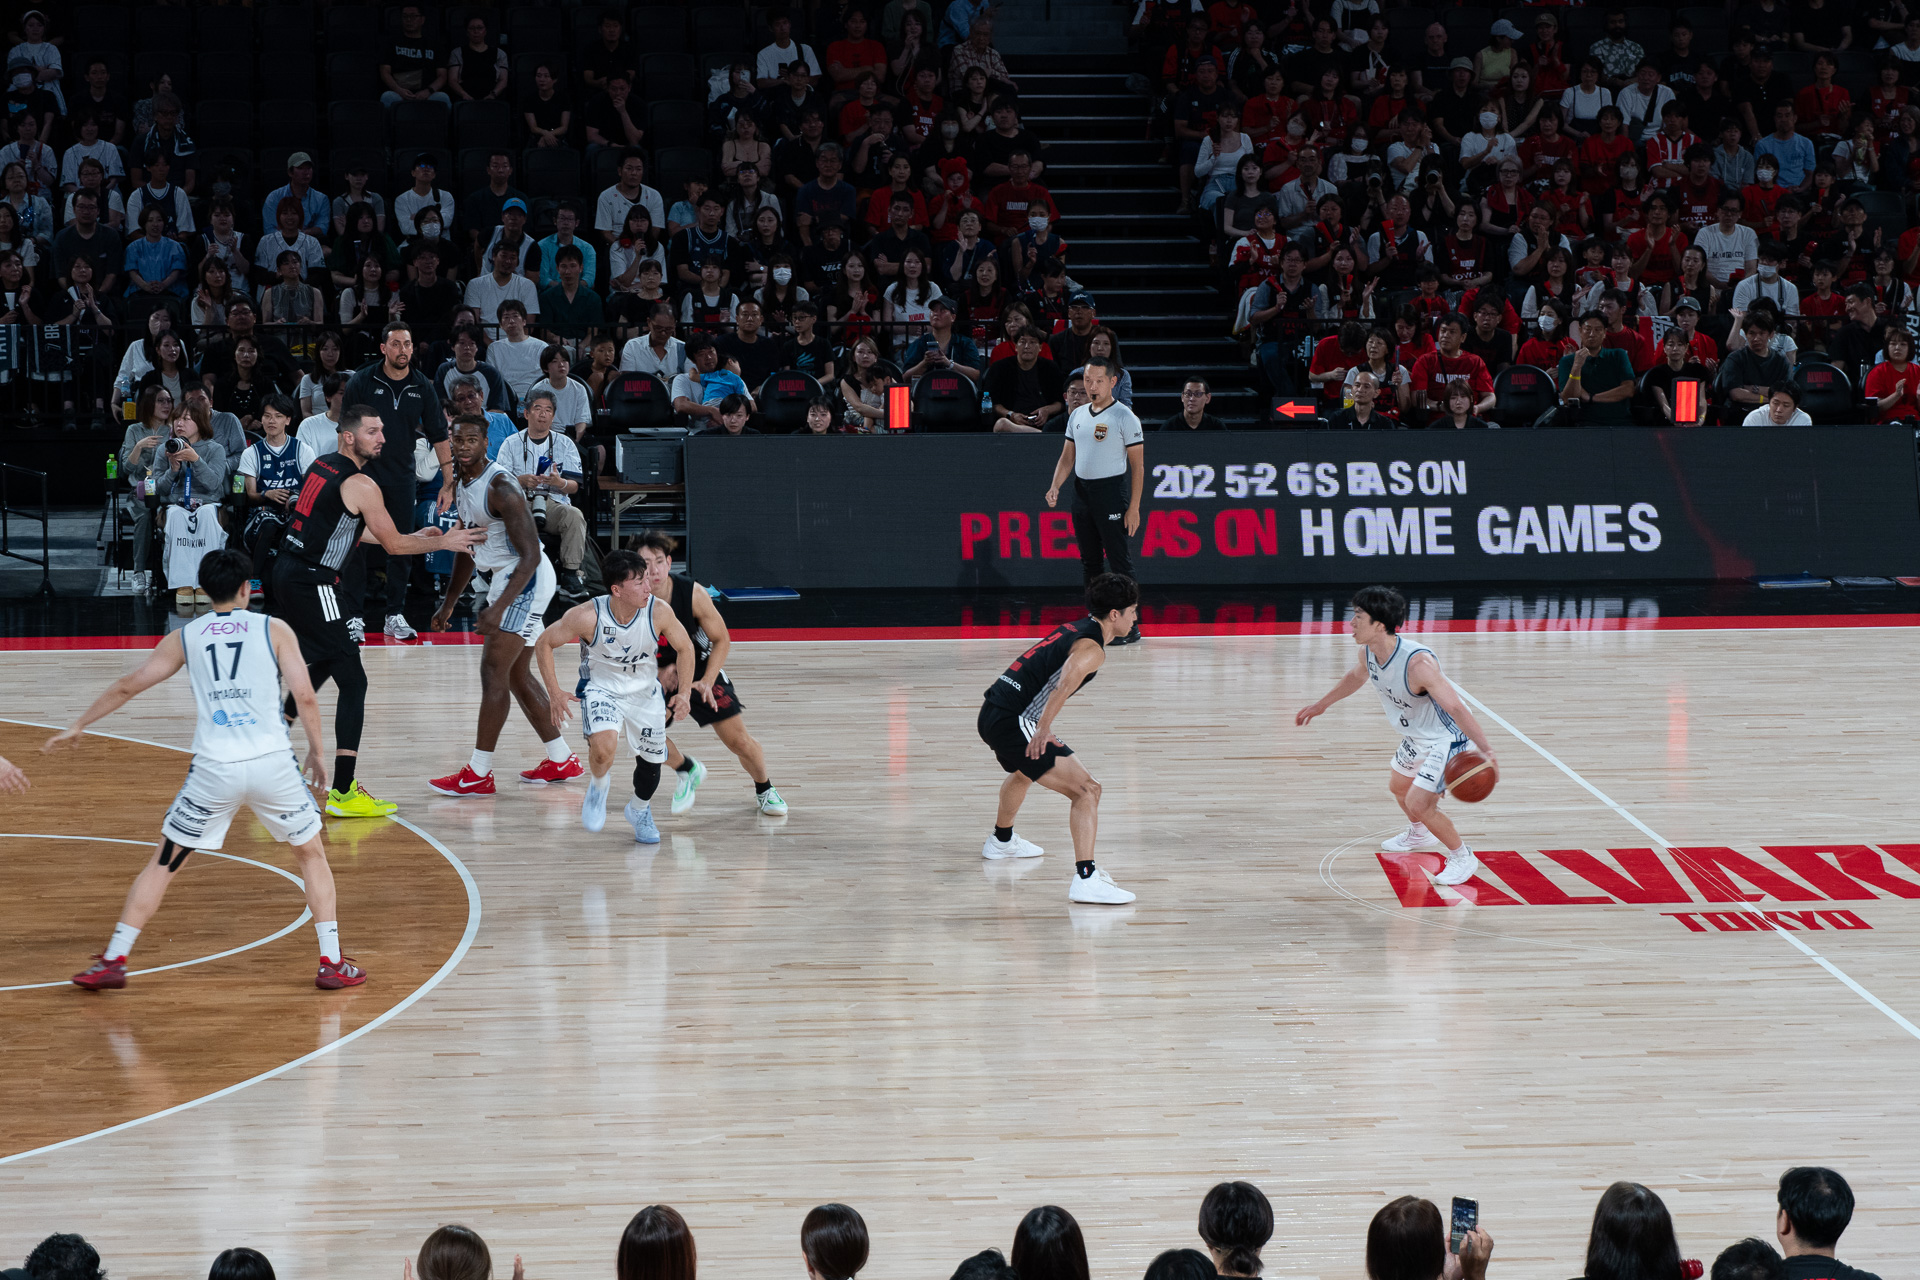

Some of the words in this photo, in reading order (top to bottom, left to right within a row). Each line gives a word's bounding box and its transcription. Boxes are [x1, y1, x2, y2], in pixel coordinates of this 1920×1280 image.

[1300, 507, 1455, 556] HOME
[1477, 503, 1662, 555] GAMES
[205, 641, 243, 682] 17
[1659, 909, 1875, 932] TOKYO
